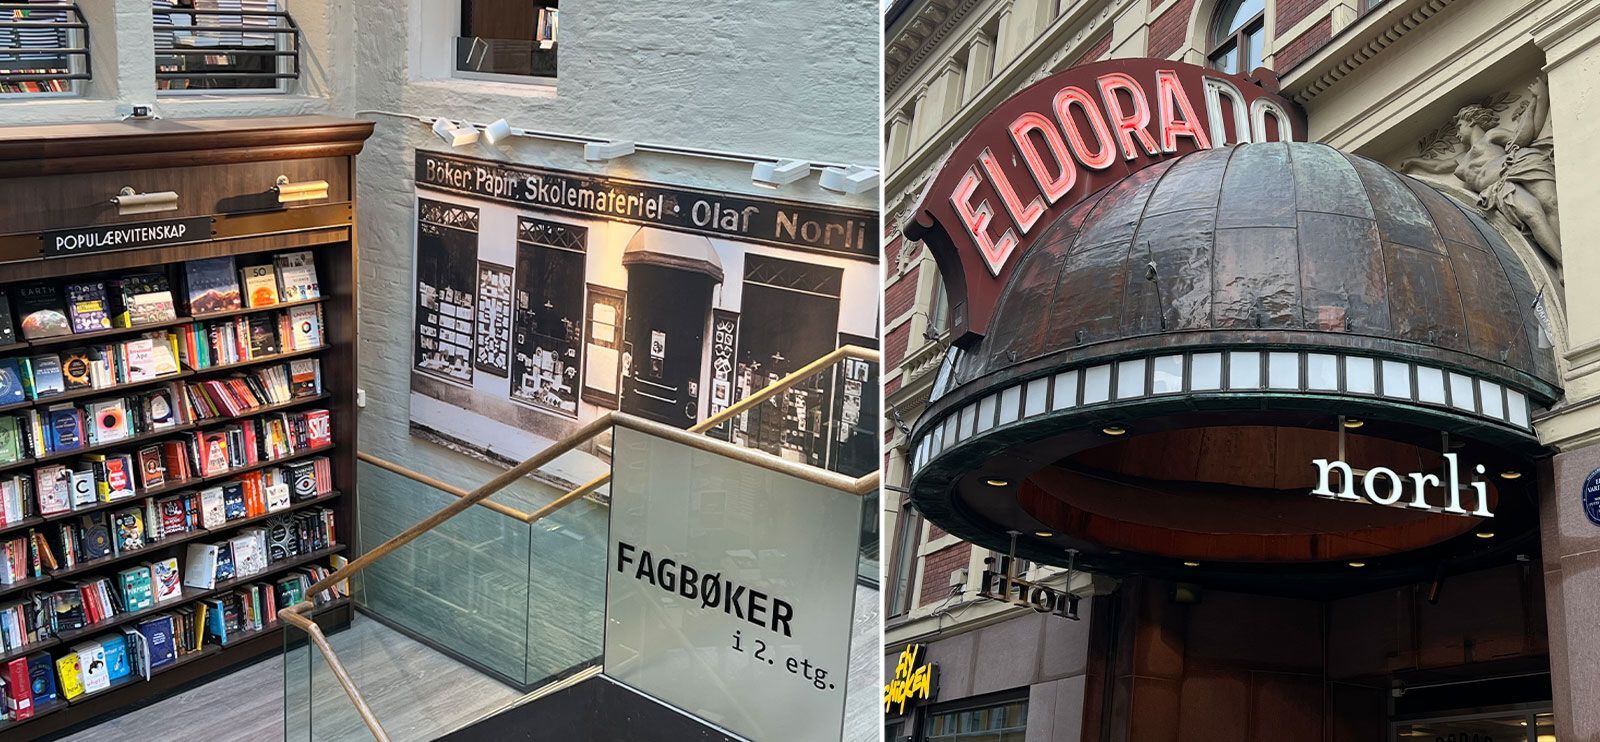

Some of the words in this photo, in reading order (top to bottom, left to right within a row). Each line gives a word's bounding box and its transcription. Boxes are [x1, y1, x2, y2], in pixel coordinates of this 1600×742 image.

[948, 69, 1294, 278] ELDORADO
[56, 223, 187, 252] POPULÆRVITENSKAP
[524, 176, 664, 220] Skolemateriel
[690, 201, 760, 233] Olaf
[775, 211, 867, 250] Norli
[21, 286, 56, 297] EARTH
[253, 267, 267, 277] 50
[308, 415, 331, 440] SIZE
[1312, 453, 1495, 518] norli
[617, 541, 795, 638] FAGBØKER
[732, 630, 744, 652] i
[754, 639, 774, 666] 2.
[785, 657, 836, 691] etg.
